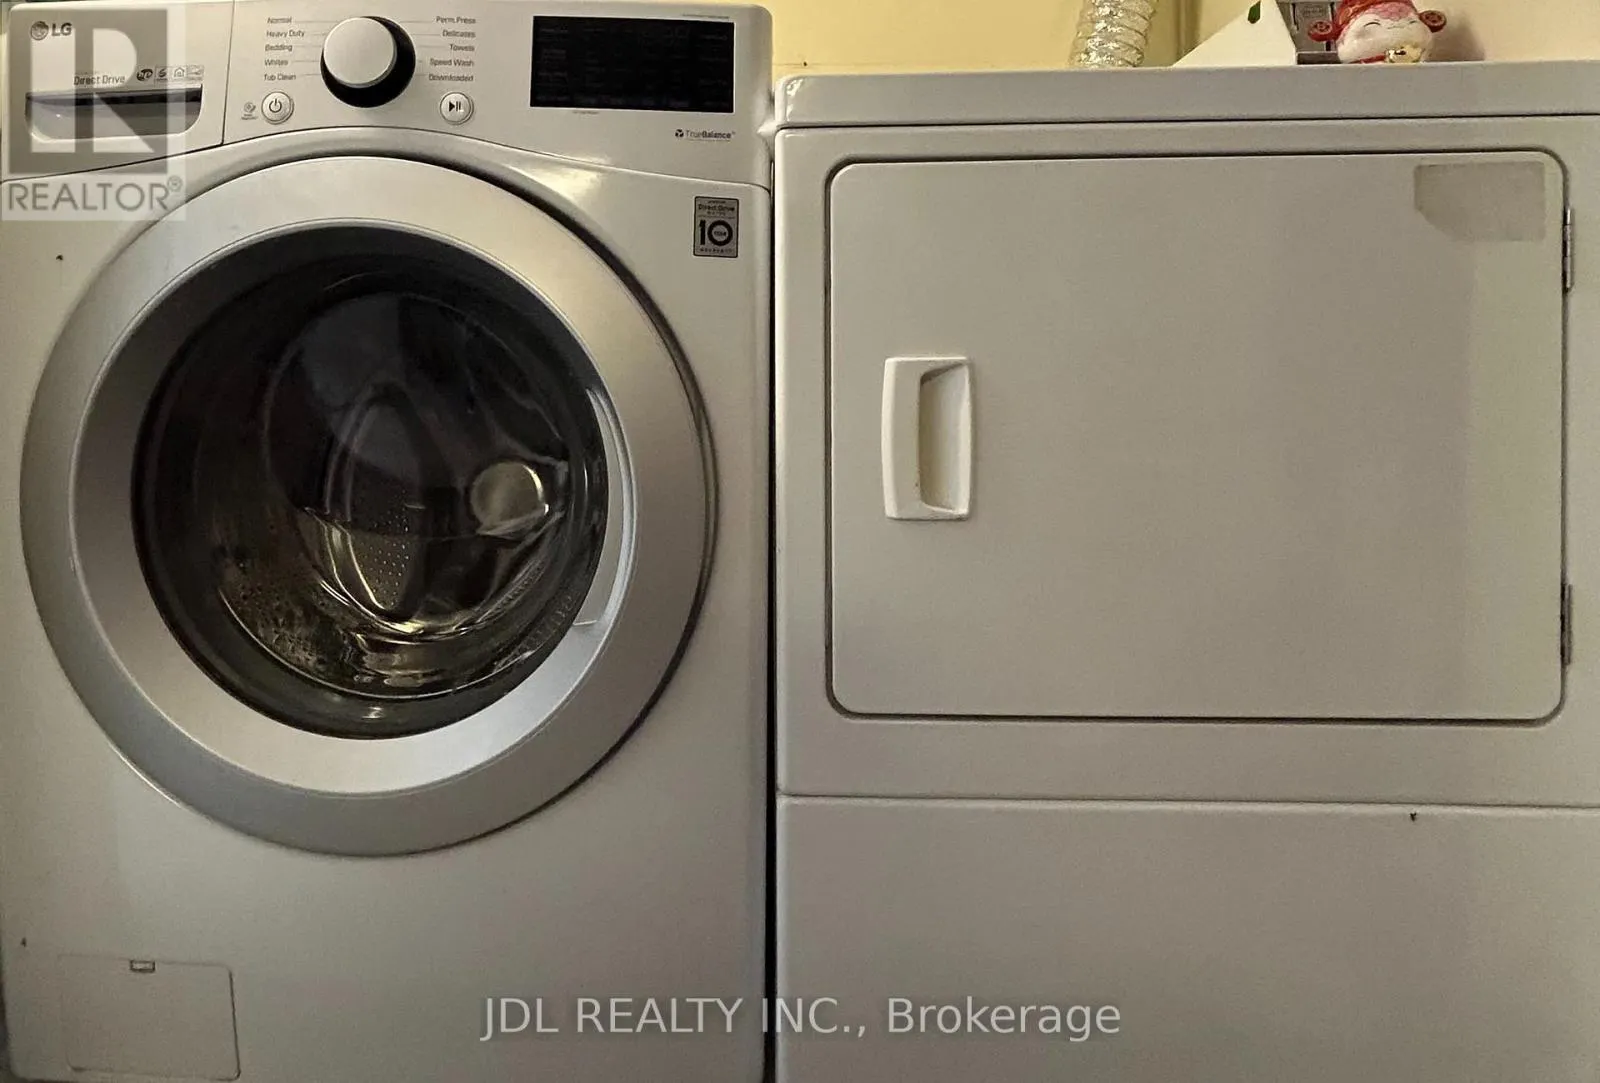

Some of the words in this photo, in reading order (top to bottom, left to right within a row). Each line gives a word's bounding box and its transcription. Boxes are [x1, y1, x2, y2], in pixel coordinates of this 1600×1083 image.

[52, 22, 72, 36] LG
[266, 30, 288, 38] Heavy
[289, 29, 304, 37] Duty
[442, 29, 476, 38] Delicates
[265, 44, 292, 52] Bedding
[449, 43, 475, 52] Towels
[430, 58, 452, 66] Speed
[74, 75, 101, 86] Direct
[102, 74, 125, 85] Drive
[264, 73, 277, 81] Tub
[277, 73, 296, 81] Clean
[428, 73, 474, 82] Downloaded
[699, 219, 733, 247] 10
